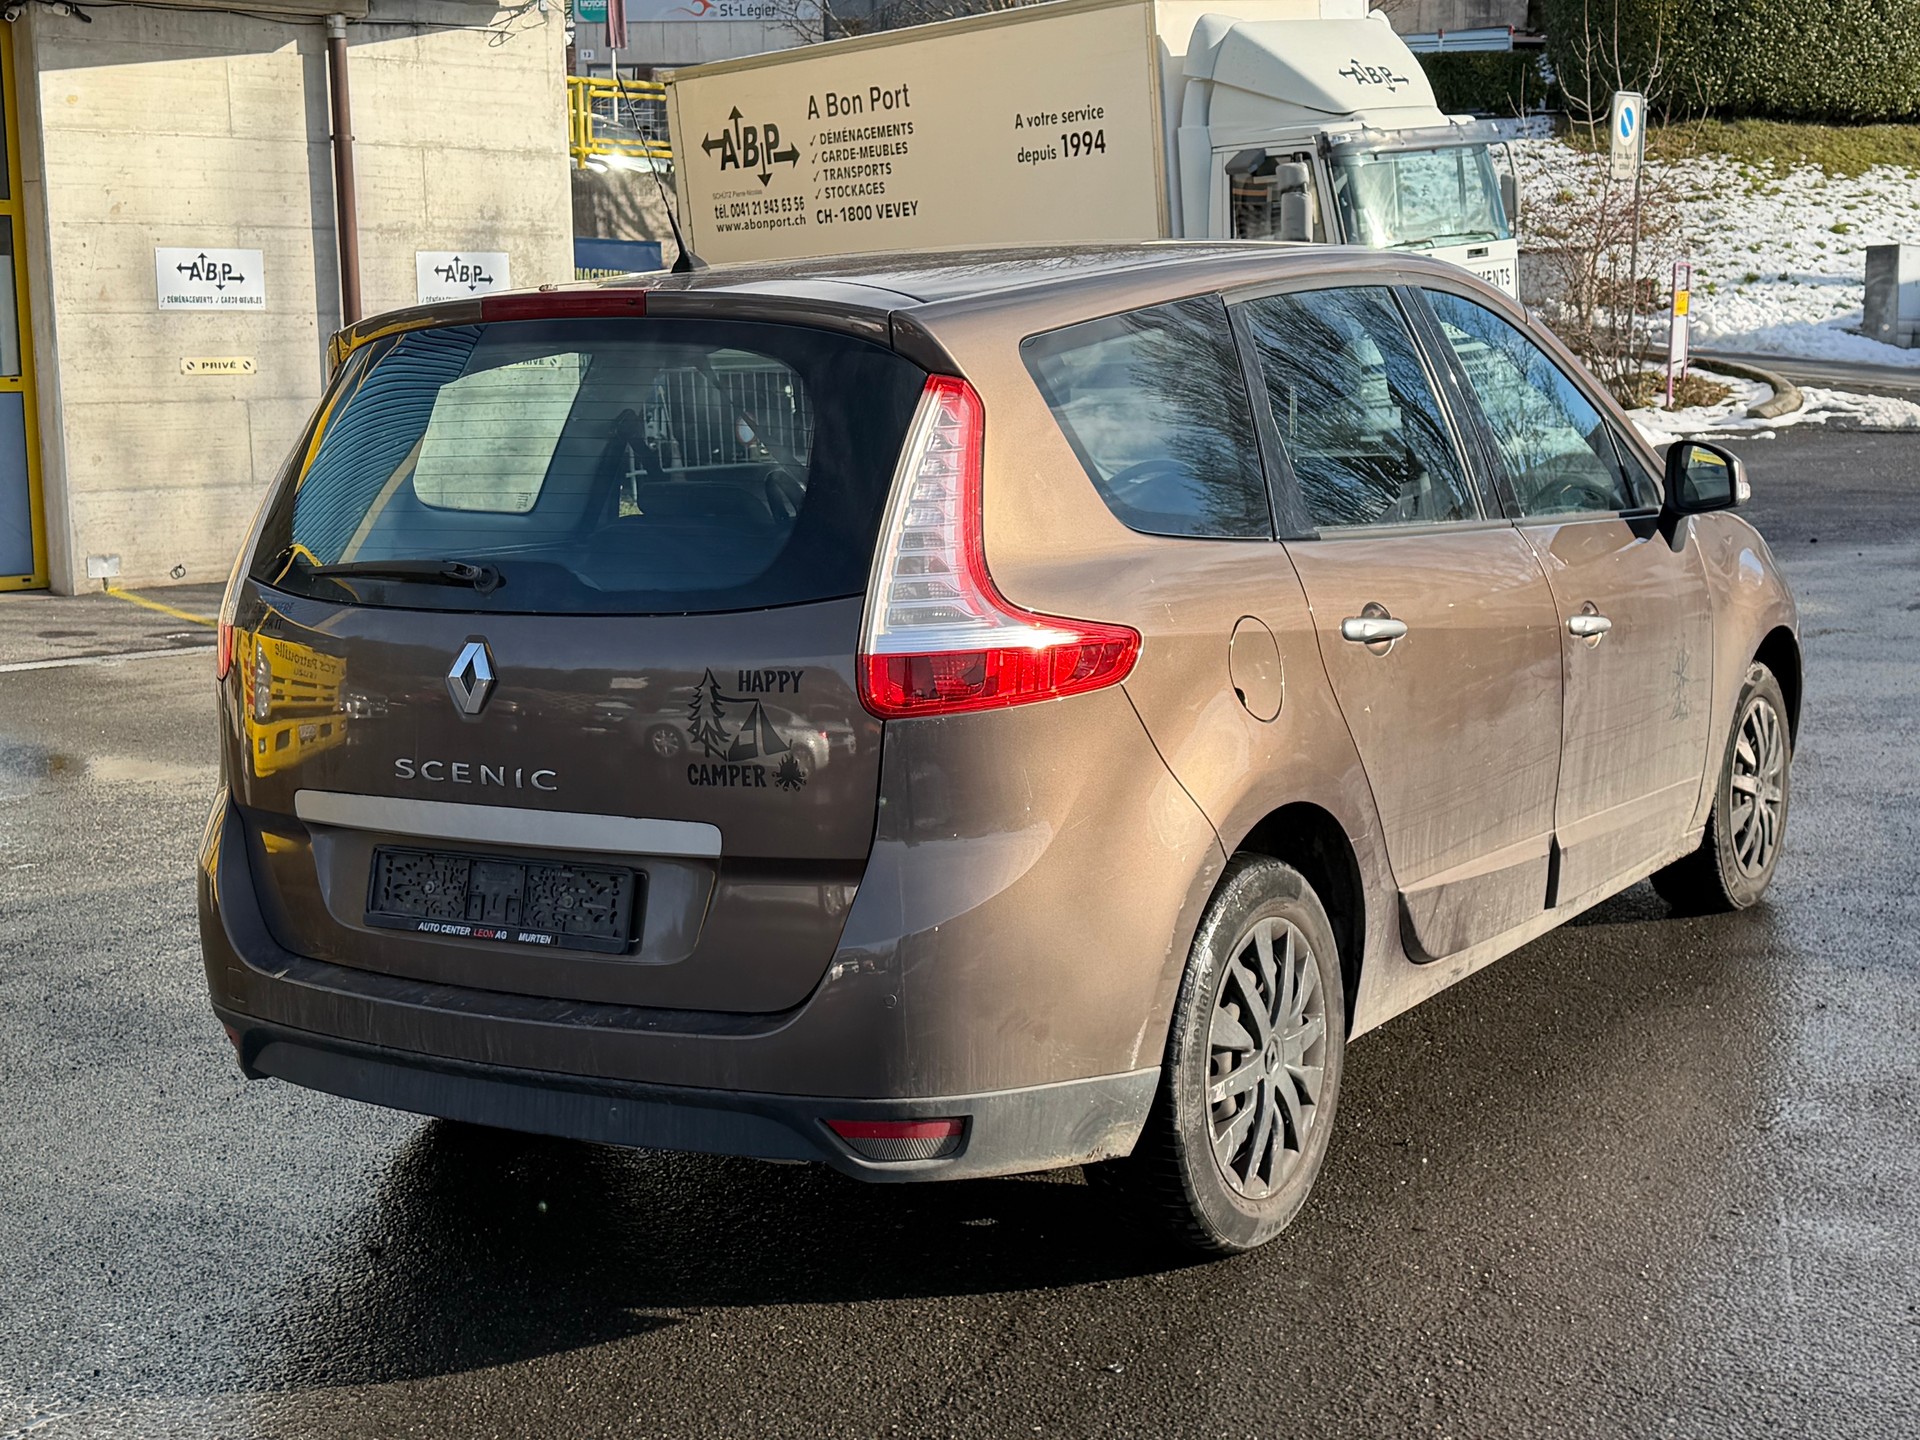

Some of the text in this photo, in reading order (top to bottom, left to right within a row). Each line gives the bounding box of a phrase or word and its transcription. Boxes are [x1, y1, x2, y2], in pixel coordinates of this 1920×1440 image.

[720, 3, 776, 19] St-Légier
[808, 83, 911, 120] A Bon Port
[1015, 104, 1104, 130] A votre service
[819, 121, 914, 146] DÉMÉNAGEMENTS
[721, 123, 780, 171] ABP
[821, 141, 908, 163] GARDE-MEUBLES
[1017, 129, 1106, 166] depuis 1994
[823, 162, 892, 181] TRANSPORTS
[824, 181, 886, 200] STOCKAGES
[714, 195, 805, 220] tél. 0041 21 943 63 56
[875, 200, 919, 219] VEVEY
[716, 213, 806, 233] www.abonport.ch
[188, 261, 233, 281] ABP
[444, 264, 483, 283] ABP
[201, 360, 237, 369] PRIVÉ
[738, 669, 804, 694] HAPPY
[394, 758, 559, 791] SCENIC
[687, 763, 767, 788] CAMPER
[417, 921, 552, 945] AUTO CENTER LEON AG MURTEN
